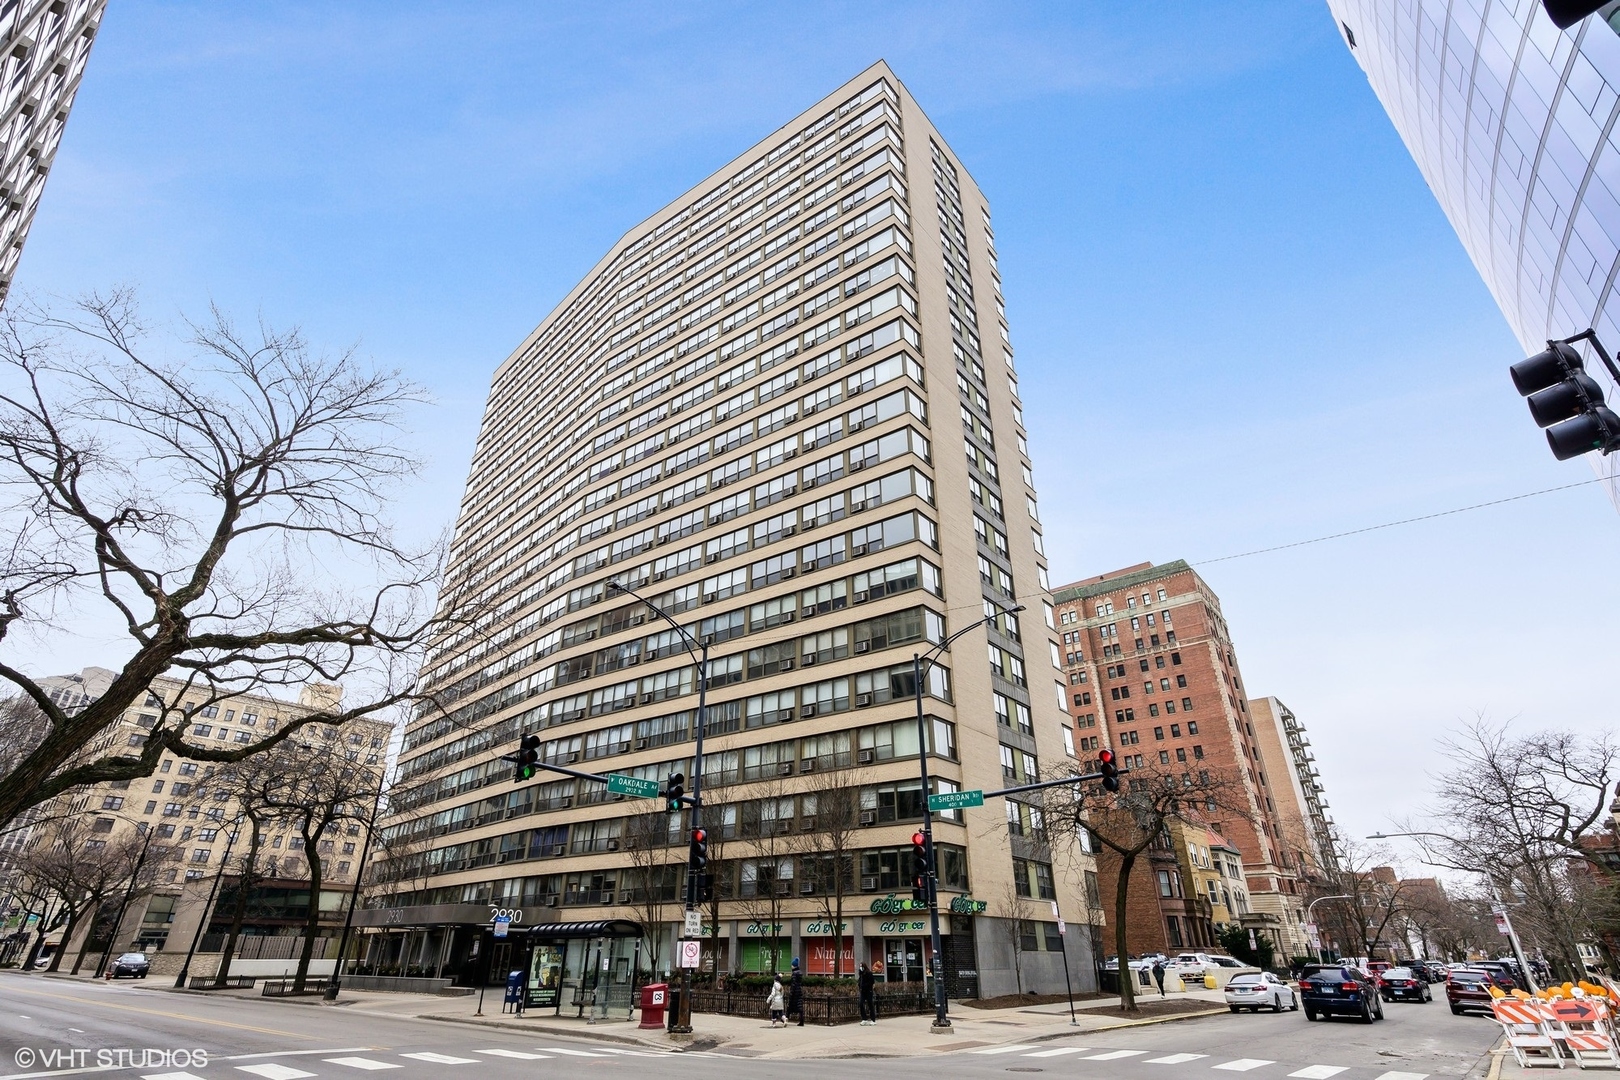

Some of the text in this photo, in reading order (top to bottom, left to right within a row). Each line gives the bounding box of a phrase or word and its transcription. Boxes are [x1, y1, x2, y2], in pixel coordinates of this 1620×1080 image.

[618, 777, 648, 790] OAKDALE
[938, 793, 970, 803] SHERIDAN
[490, 908, 523, 924] 2930
[898, 921, 925, 932] grocer
[654, 993, 663, 1001] CS
